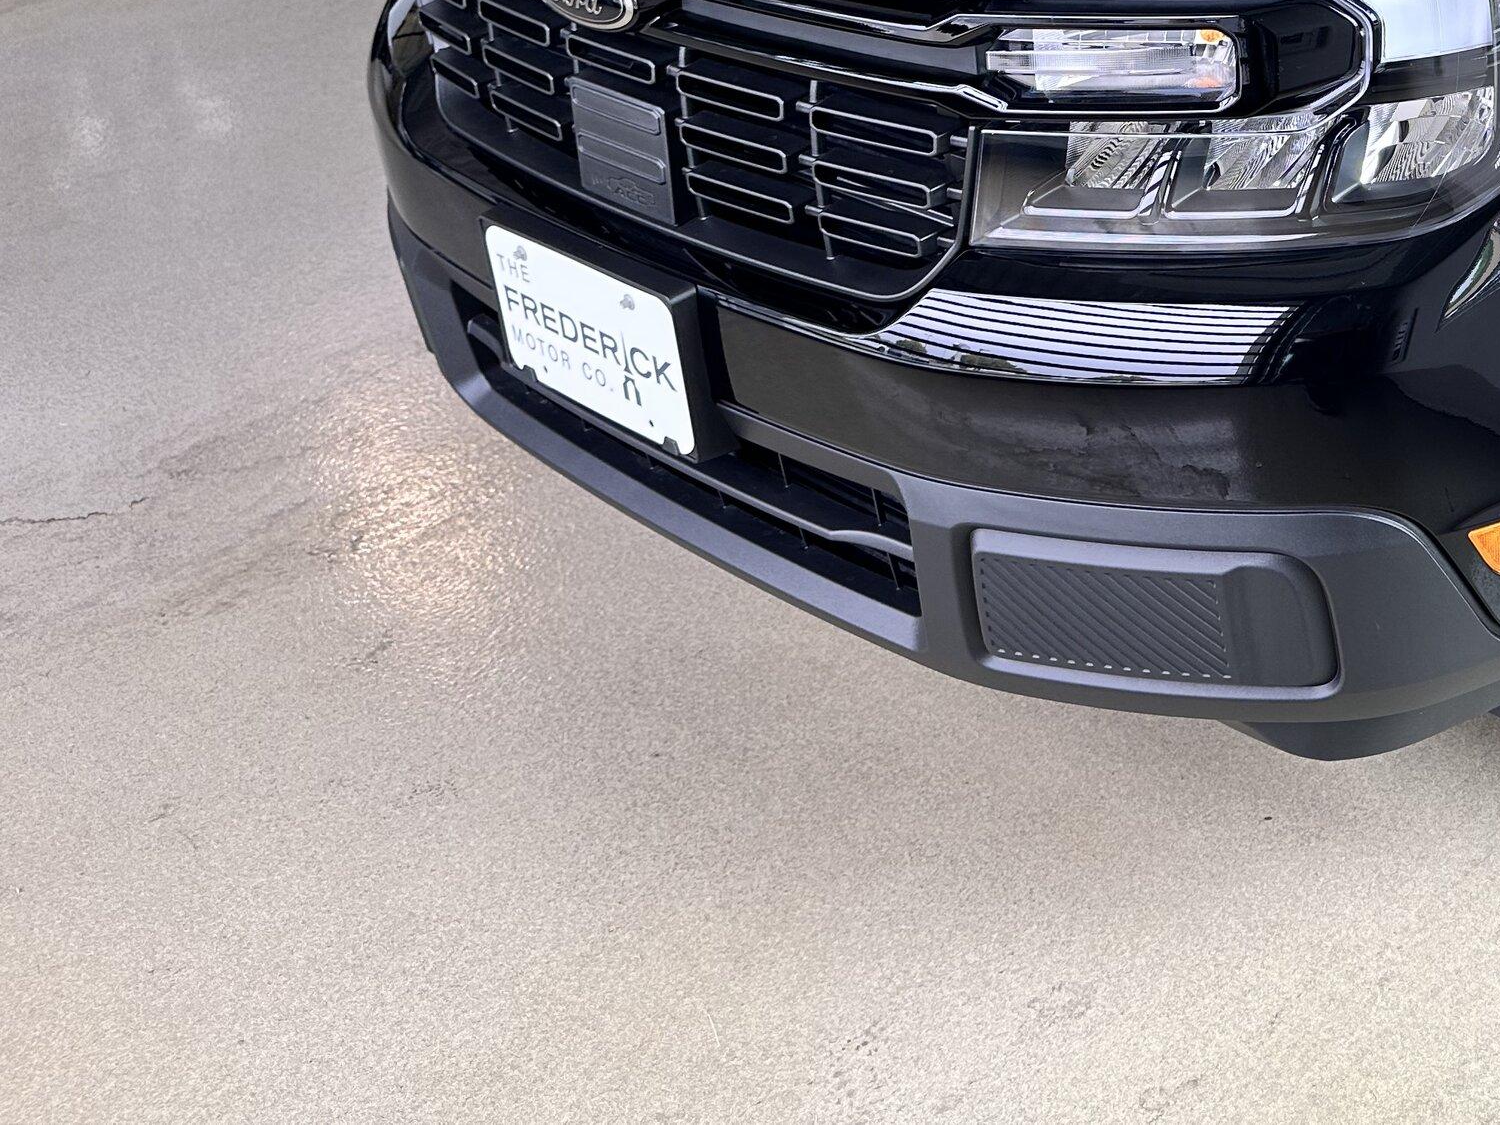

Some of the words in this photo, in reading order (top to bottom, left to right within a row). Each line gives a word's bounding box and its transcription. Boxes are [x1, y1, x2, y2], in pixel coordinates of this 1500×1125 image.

[496, 253, 532, 283] THE
[503, 284, 678, 393] FREDERICK
[510, 324, 572, 370] MOTOR
[581, 361, 615, 392] CO.
